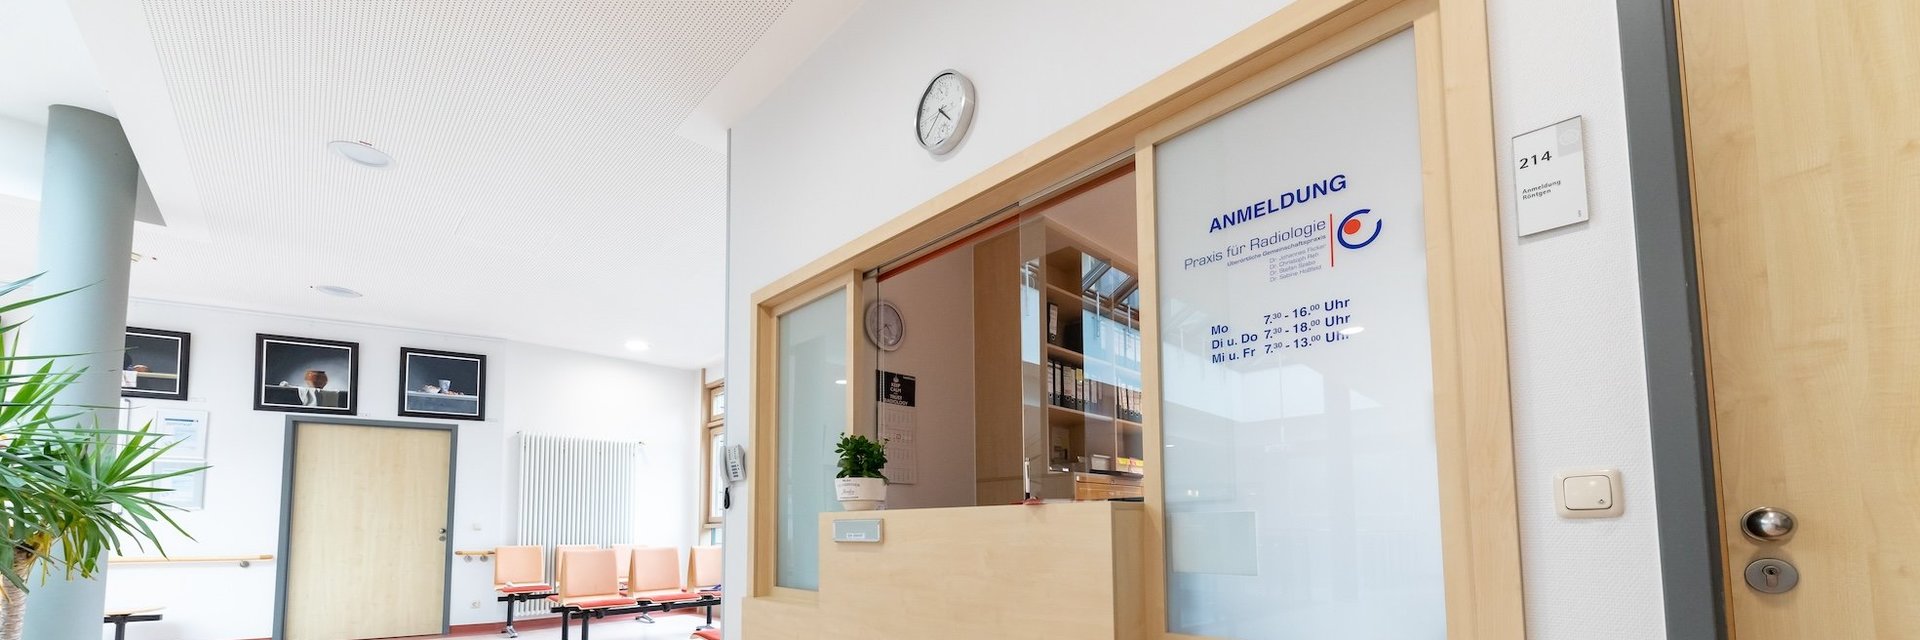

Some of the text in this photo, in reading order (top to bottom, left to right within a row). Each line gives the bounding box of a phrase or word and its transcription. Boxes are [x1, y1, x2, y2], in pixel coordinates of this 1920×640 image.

[1520, 150, 1552, 169] 214
[1209, 174, 1347, 233] ANMELDUNG
[1522, 180, 1561, 194] Anmeldung
[1522, 188, 1552, 200] Röntgen
[1184, 220, 1326, 270] Praxis für Radiologie
[1263, 235, 1326, 257] Gemeinschaftspraxis
[1211, 325, 1228, 335] Mo
[1325, 298, 1350, 312] Uhr
[1212, 338, 1223, 349] Di
[1227, 339, 1238, 347] u.
[1241, 332, 1258, 343] Do
[1325, 314, 1350, 327] Uhr
[1212, 353, 1225, 364] Mi
[1243, 348, 1256, 358] Fr
[1326, 331, 1349, 343] Uh
